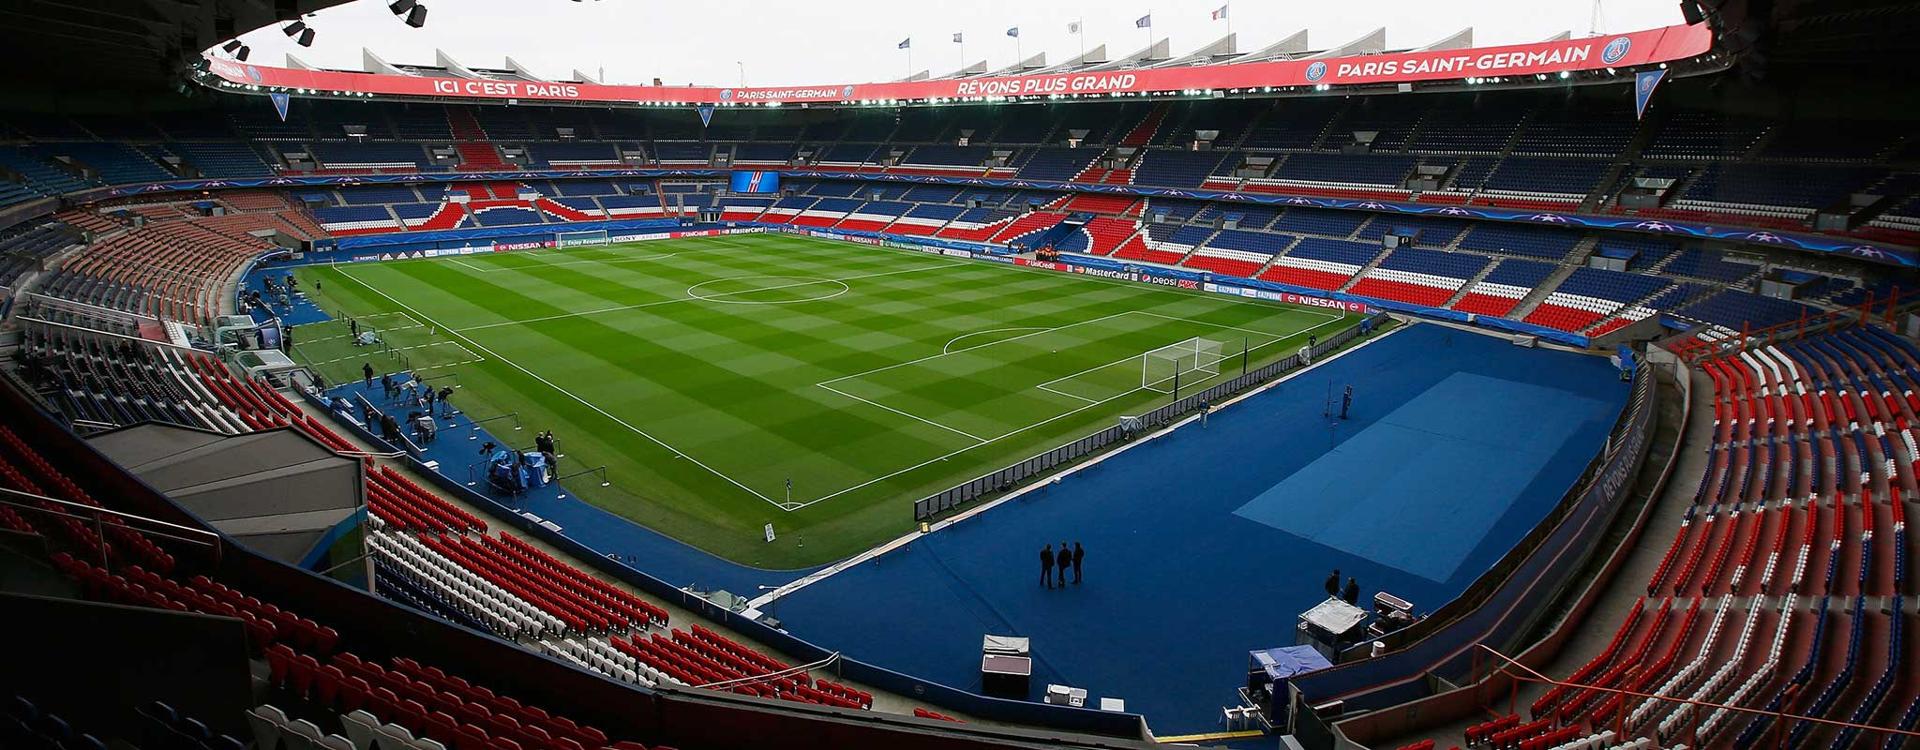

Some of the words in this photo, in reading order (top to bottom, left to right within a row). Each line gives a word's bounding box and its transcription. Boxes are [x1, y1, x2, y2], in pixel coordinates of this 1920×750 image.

[1336, 60, 1398, 78] PARIS
[1402, 44, 1592, 76] SAINT-GERMAIN
[434, 80, 460, 94] ICI
[466, 80, 518, 96] C'EST
[526, 83, 579, 98] PARIS
[957, 80, 1021, 95] RÊVONS
[1024, 78, 1066, 93] PLUS
[1072, 74, 1136, 92] GRAND
[737, 90, 765, 99] PARIS
[766, 89, 838, 99] SAINT-GERMAIN
[1030, 260, 1056, 270] UniCredit
[1085, 267, 1130, 280] MasterCard
[1152, 276, 1177, 287] pepsi
[1298, 295, 1346, 310] NISSAN
